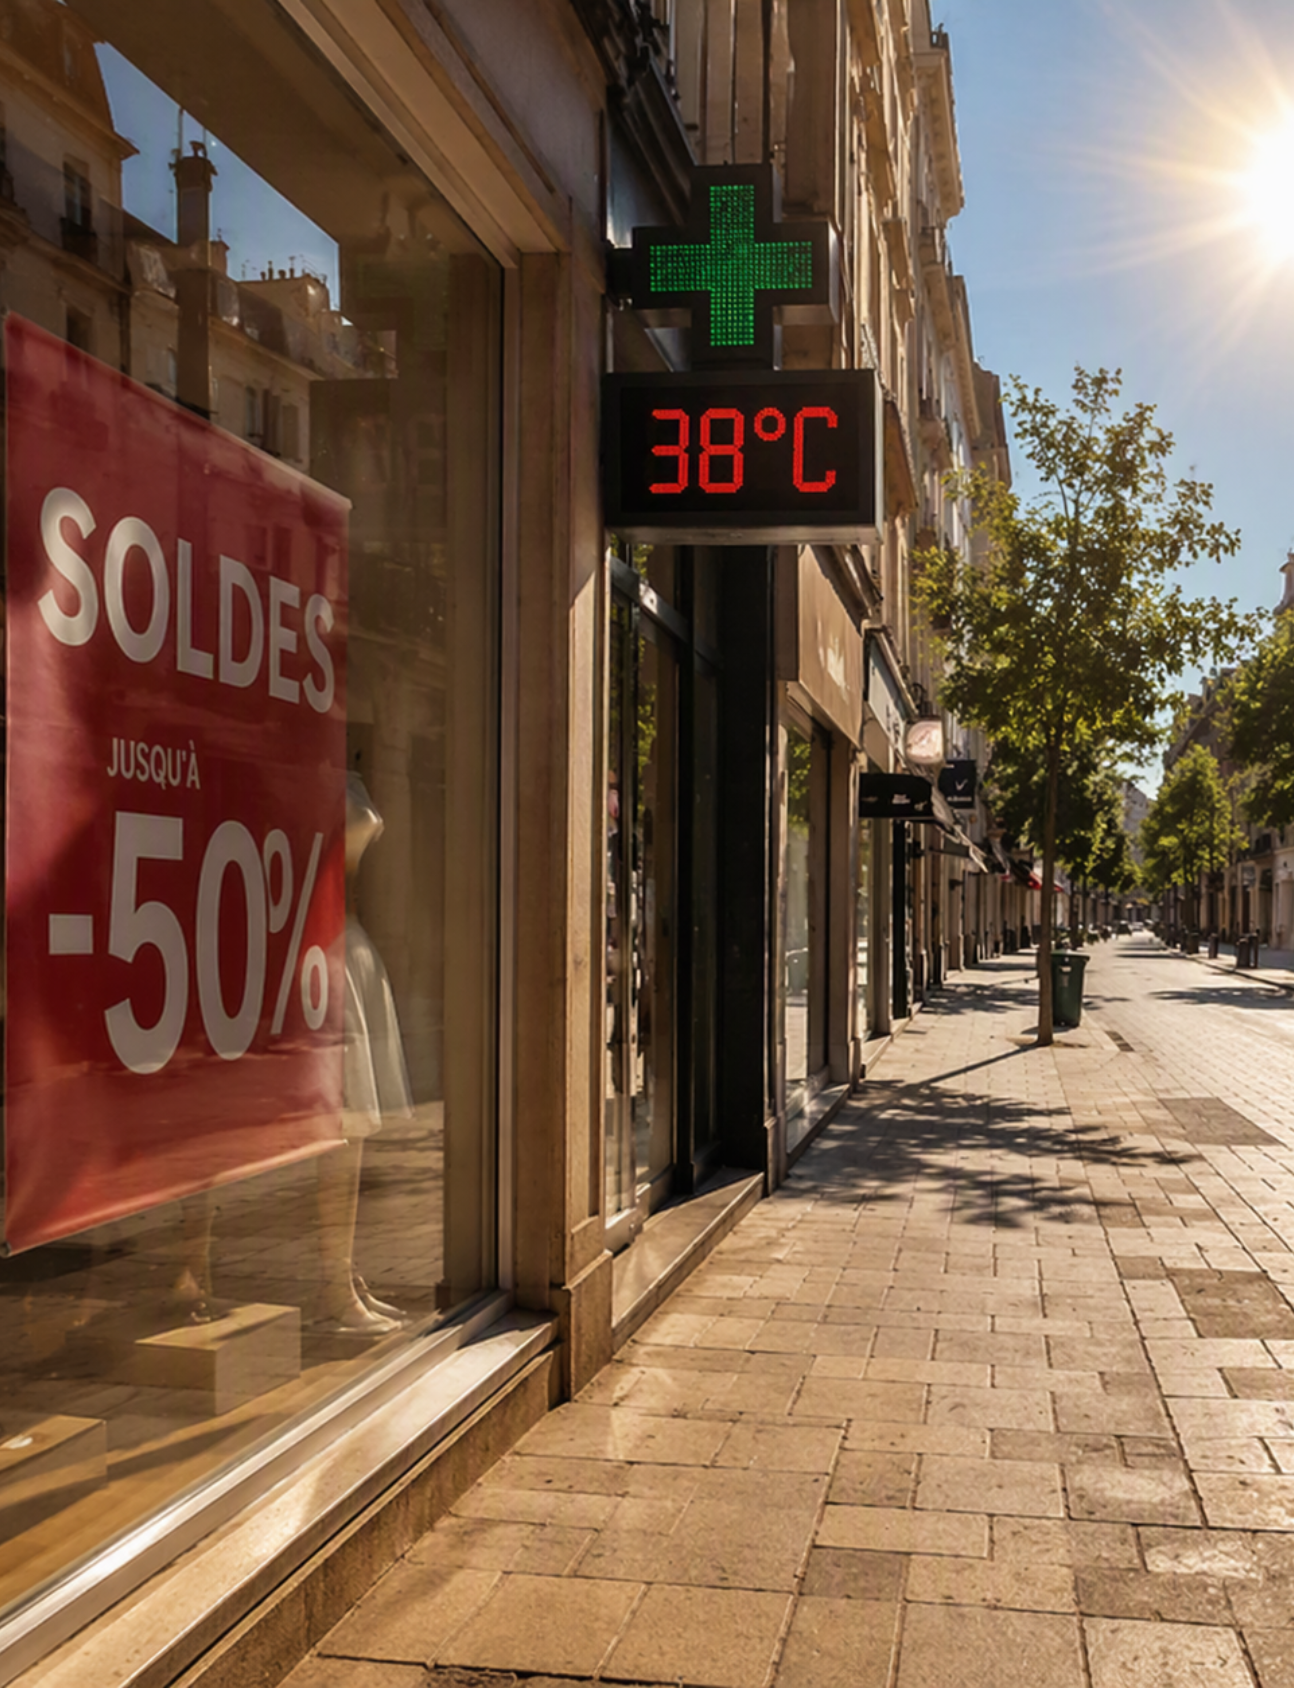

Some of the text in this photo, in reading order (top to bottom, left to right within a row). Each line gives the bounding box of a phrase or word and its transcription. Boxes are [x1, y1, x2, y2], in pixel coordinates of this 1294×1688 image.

[649, 406, 838, 493] 38°C
[38, 487, 335, 713] SOLDES
[107, 737, 200, 790] JUSQU'À
[49, 811, 329, 1075] -50%
